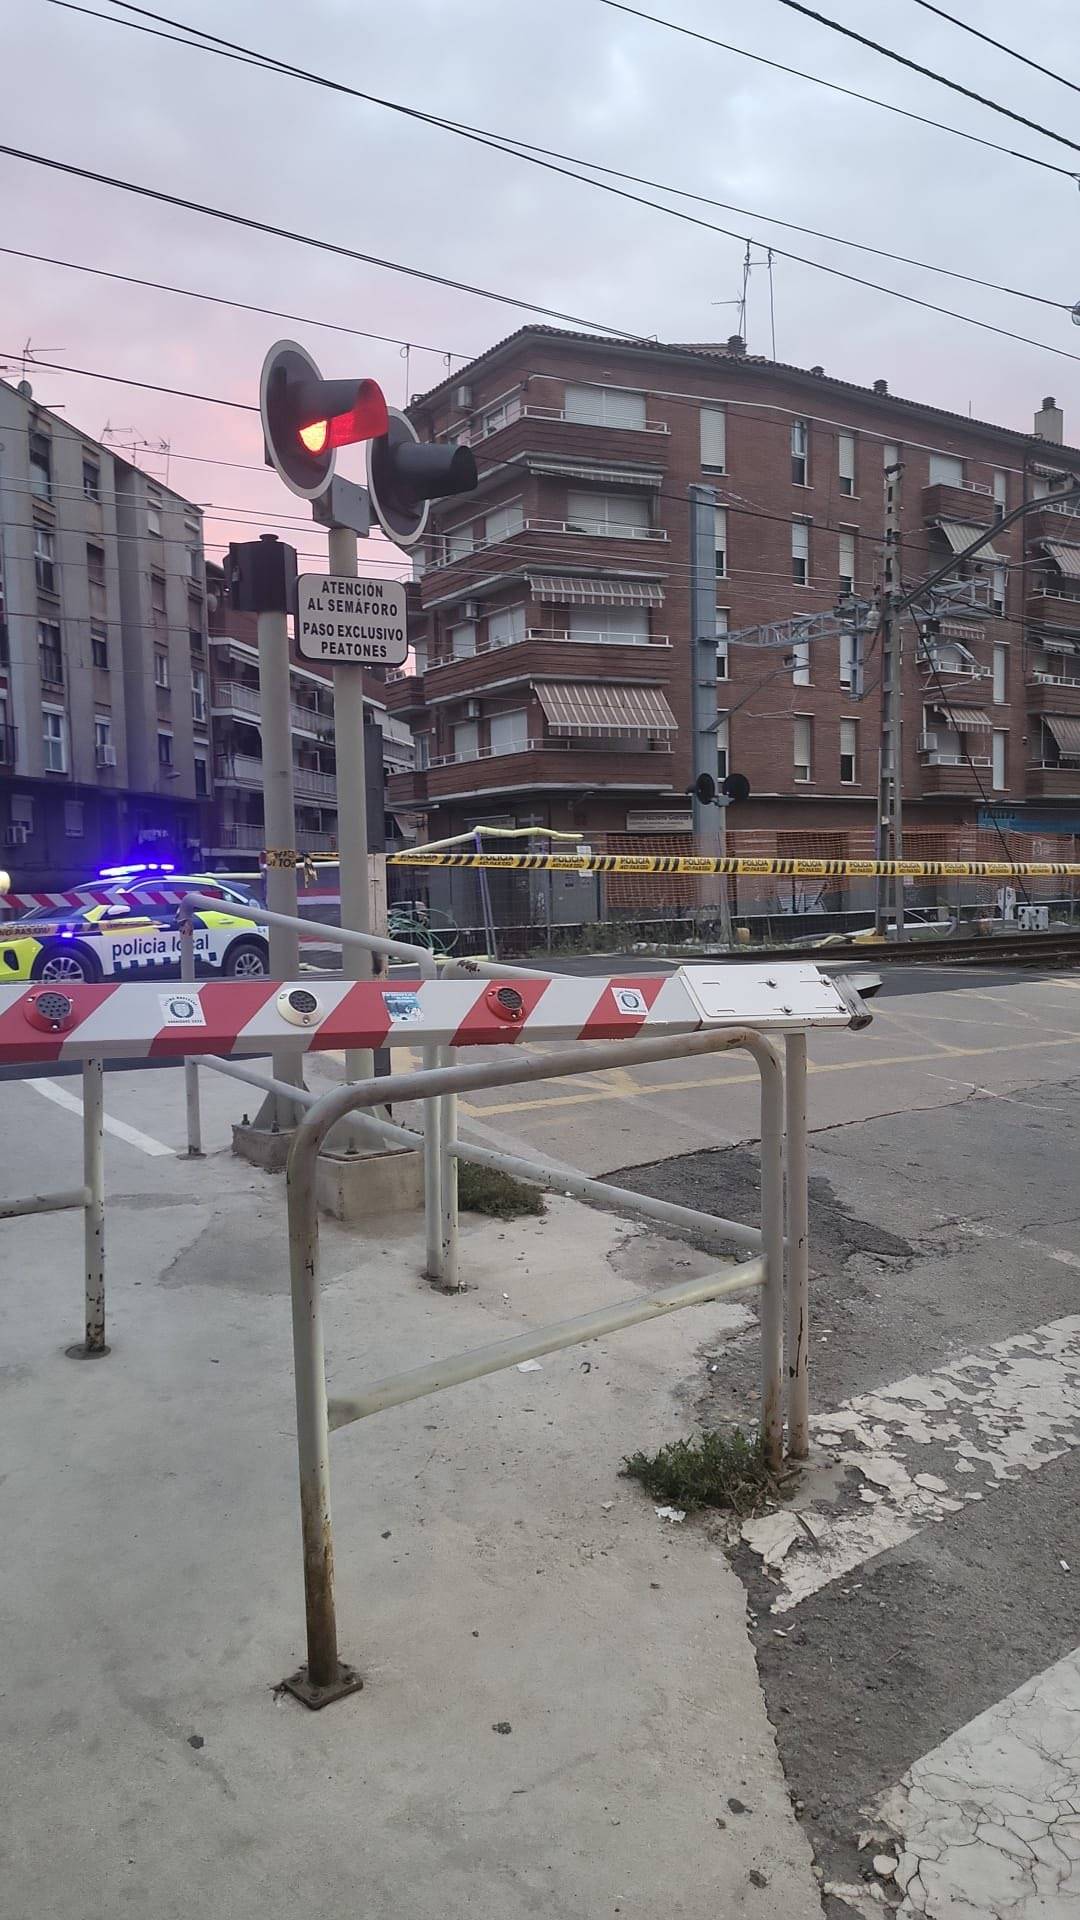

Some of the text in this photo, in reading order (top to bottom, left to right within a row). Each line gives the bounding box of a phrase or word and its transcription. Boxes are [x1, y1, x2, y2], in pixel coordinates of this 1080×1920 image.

[321, 580, 383, 598] ATENCIÓN
[307, 598, 398, 617] AL SEMÁFORO
[303, 622, 403, 641] PASO EXCLUSIVO
[321, 641, 387, 658] PEATONES
[620, 857, 650, 865] POLICIA
[683, 858, 711, 866] POLICIA
[112, 933, 209, 961] policia loal
